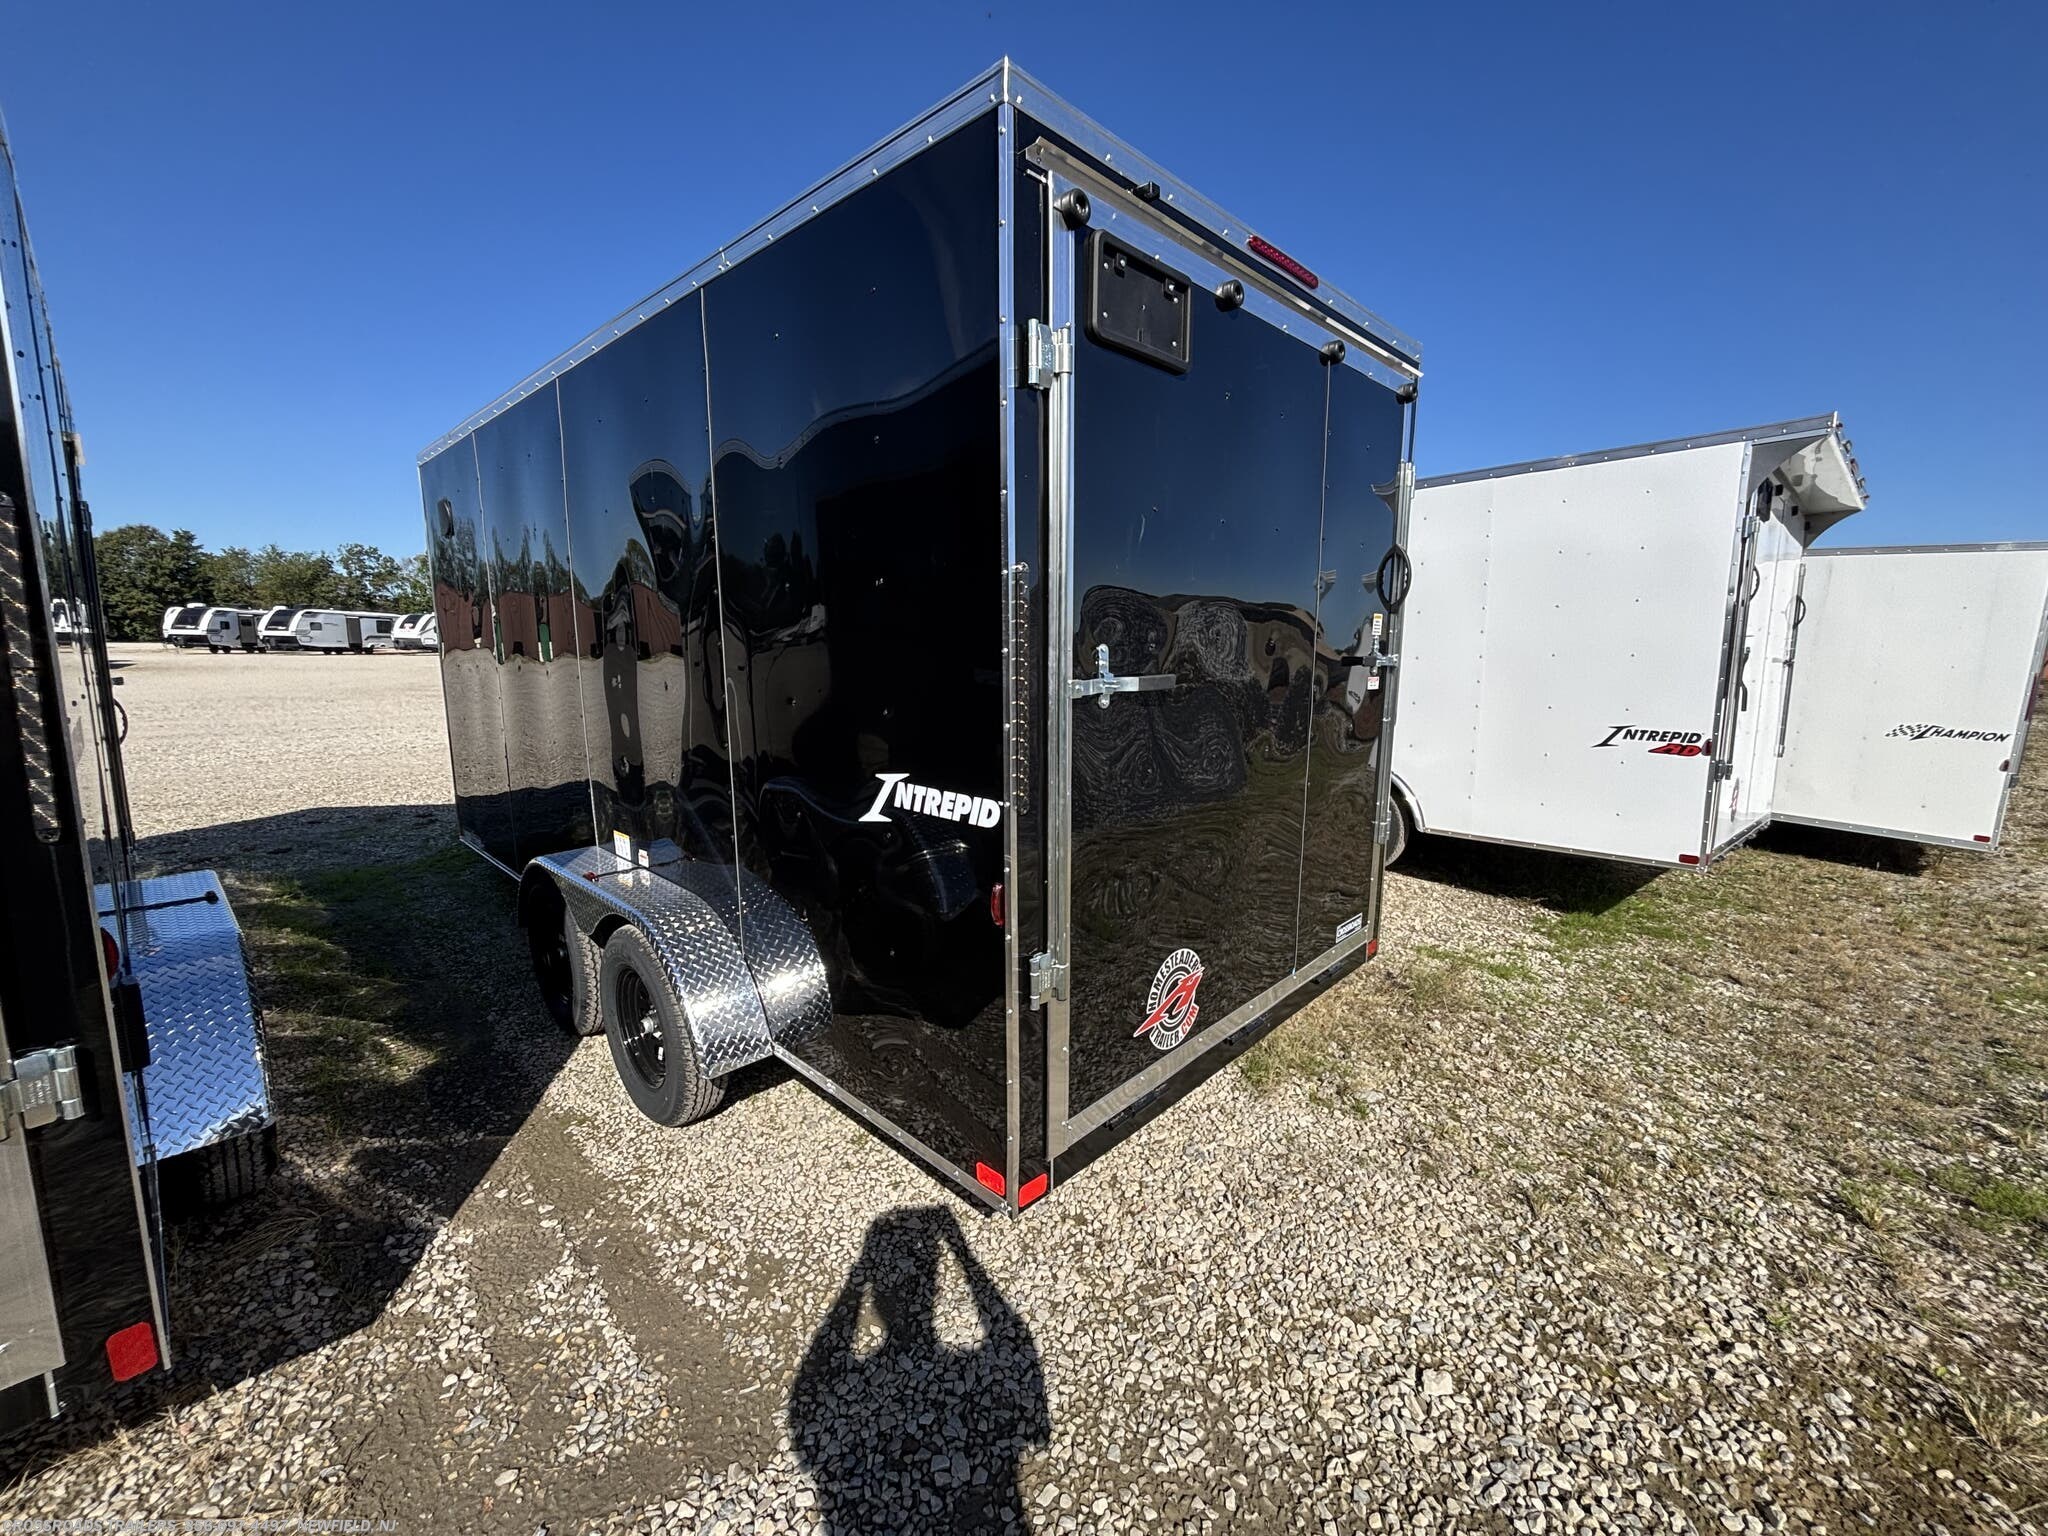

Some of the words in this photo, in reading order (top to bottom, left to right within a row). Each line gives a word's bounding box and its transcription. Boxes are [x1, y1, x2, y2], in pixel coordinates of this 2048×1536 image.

[1591, 725, 1702, 748] INTREPID
[1909, 725, 2010, 742] CHAMPION
[858, 773, 1001, 828] INTREPID
